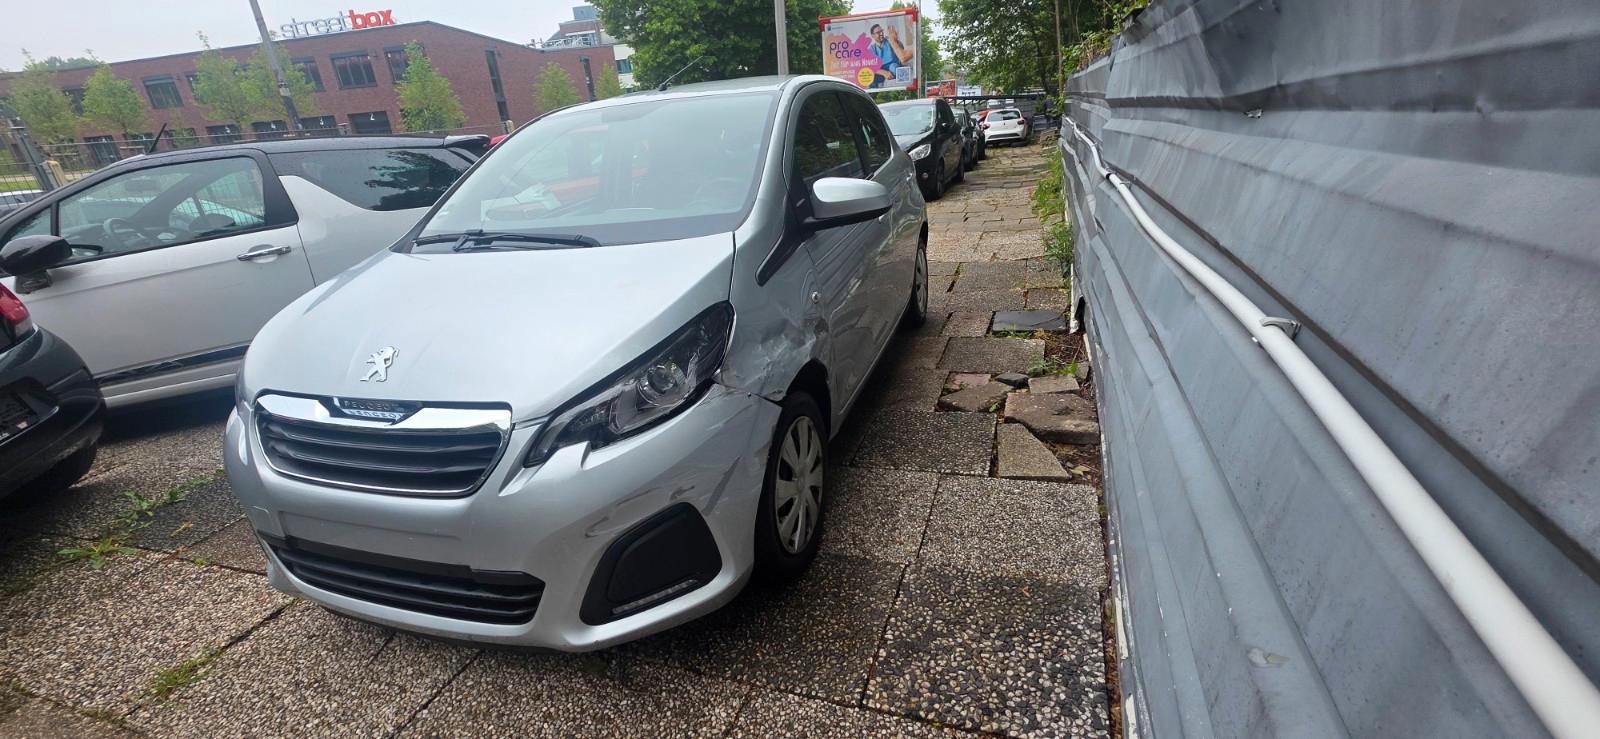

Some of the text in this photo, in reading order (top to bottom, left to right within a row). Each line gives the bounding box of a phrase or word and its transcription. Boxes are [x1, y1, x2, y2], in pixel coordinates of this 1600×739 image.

[281, 9, 394, 38] streetbox
[830, 40, 849, 55] pro
[835, 49, 861, 59] care
